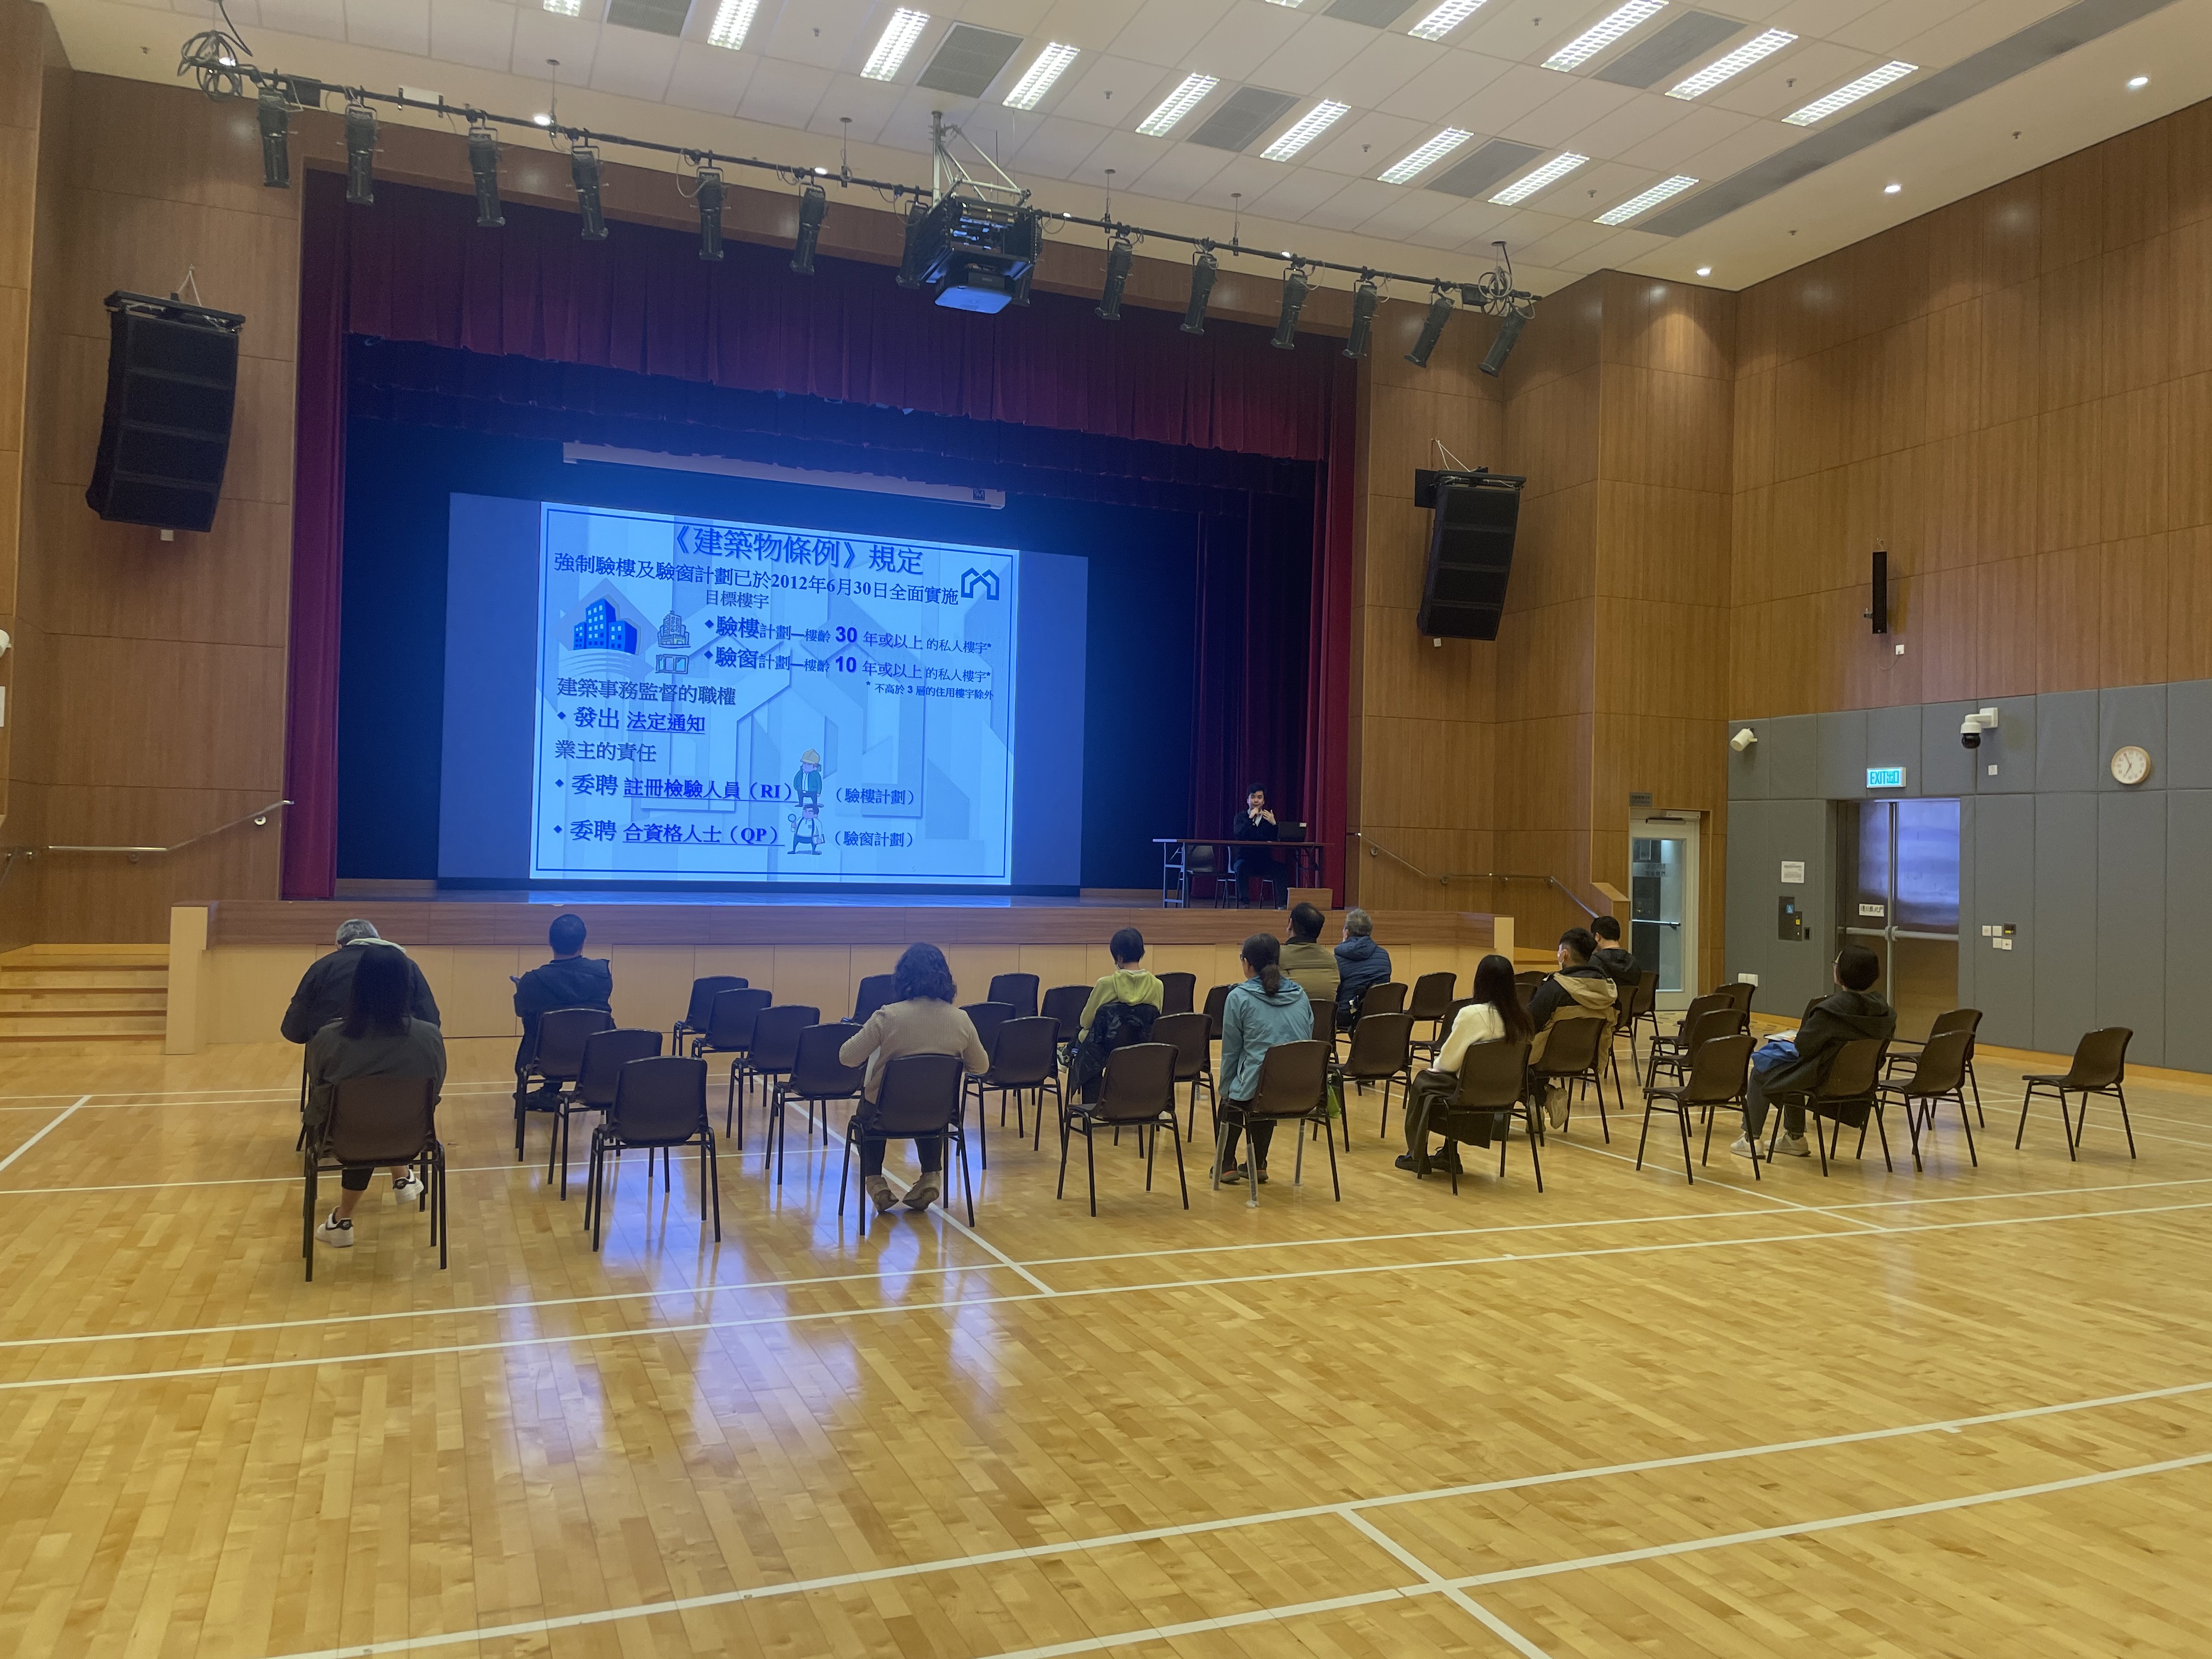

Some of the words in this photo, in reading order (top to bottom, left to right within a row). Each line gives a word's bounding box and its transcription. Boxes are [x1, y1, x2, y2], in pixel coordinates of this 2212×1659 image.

[554, 552, 958, 605] 強制驗樓及驗窗計劃已於2012年6月30日全面實施
[706, 589, 769, 610] 目標樓宇
[836, 626, 857, 643] 30
[862, 631, 923, 650] 年或以上
[836, 656, 856, 673] 10
[862, 660, 922, 679] 年或以上
[556, 677, 736, 706] 建築事務監督的職權
[907, 685, 913, 694] 3
[573, 706, 620, 729] 發出
[627, 710, 706, 732] 法定通知
[555, 740, 657, 762] 業主的責任
[571, 774, 619, 796] 委聘
[836, 787, 915, 805] （驗樓計劃）
[1870, 771, 1886, 784] EXIT
[1887, 771, 1899, 783] 出口
[570, 819, 617, 842] 委聘
[835, 831, 913, 848] （驗窗計劃）
